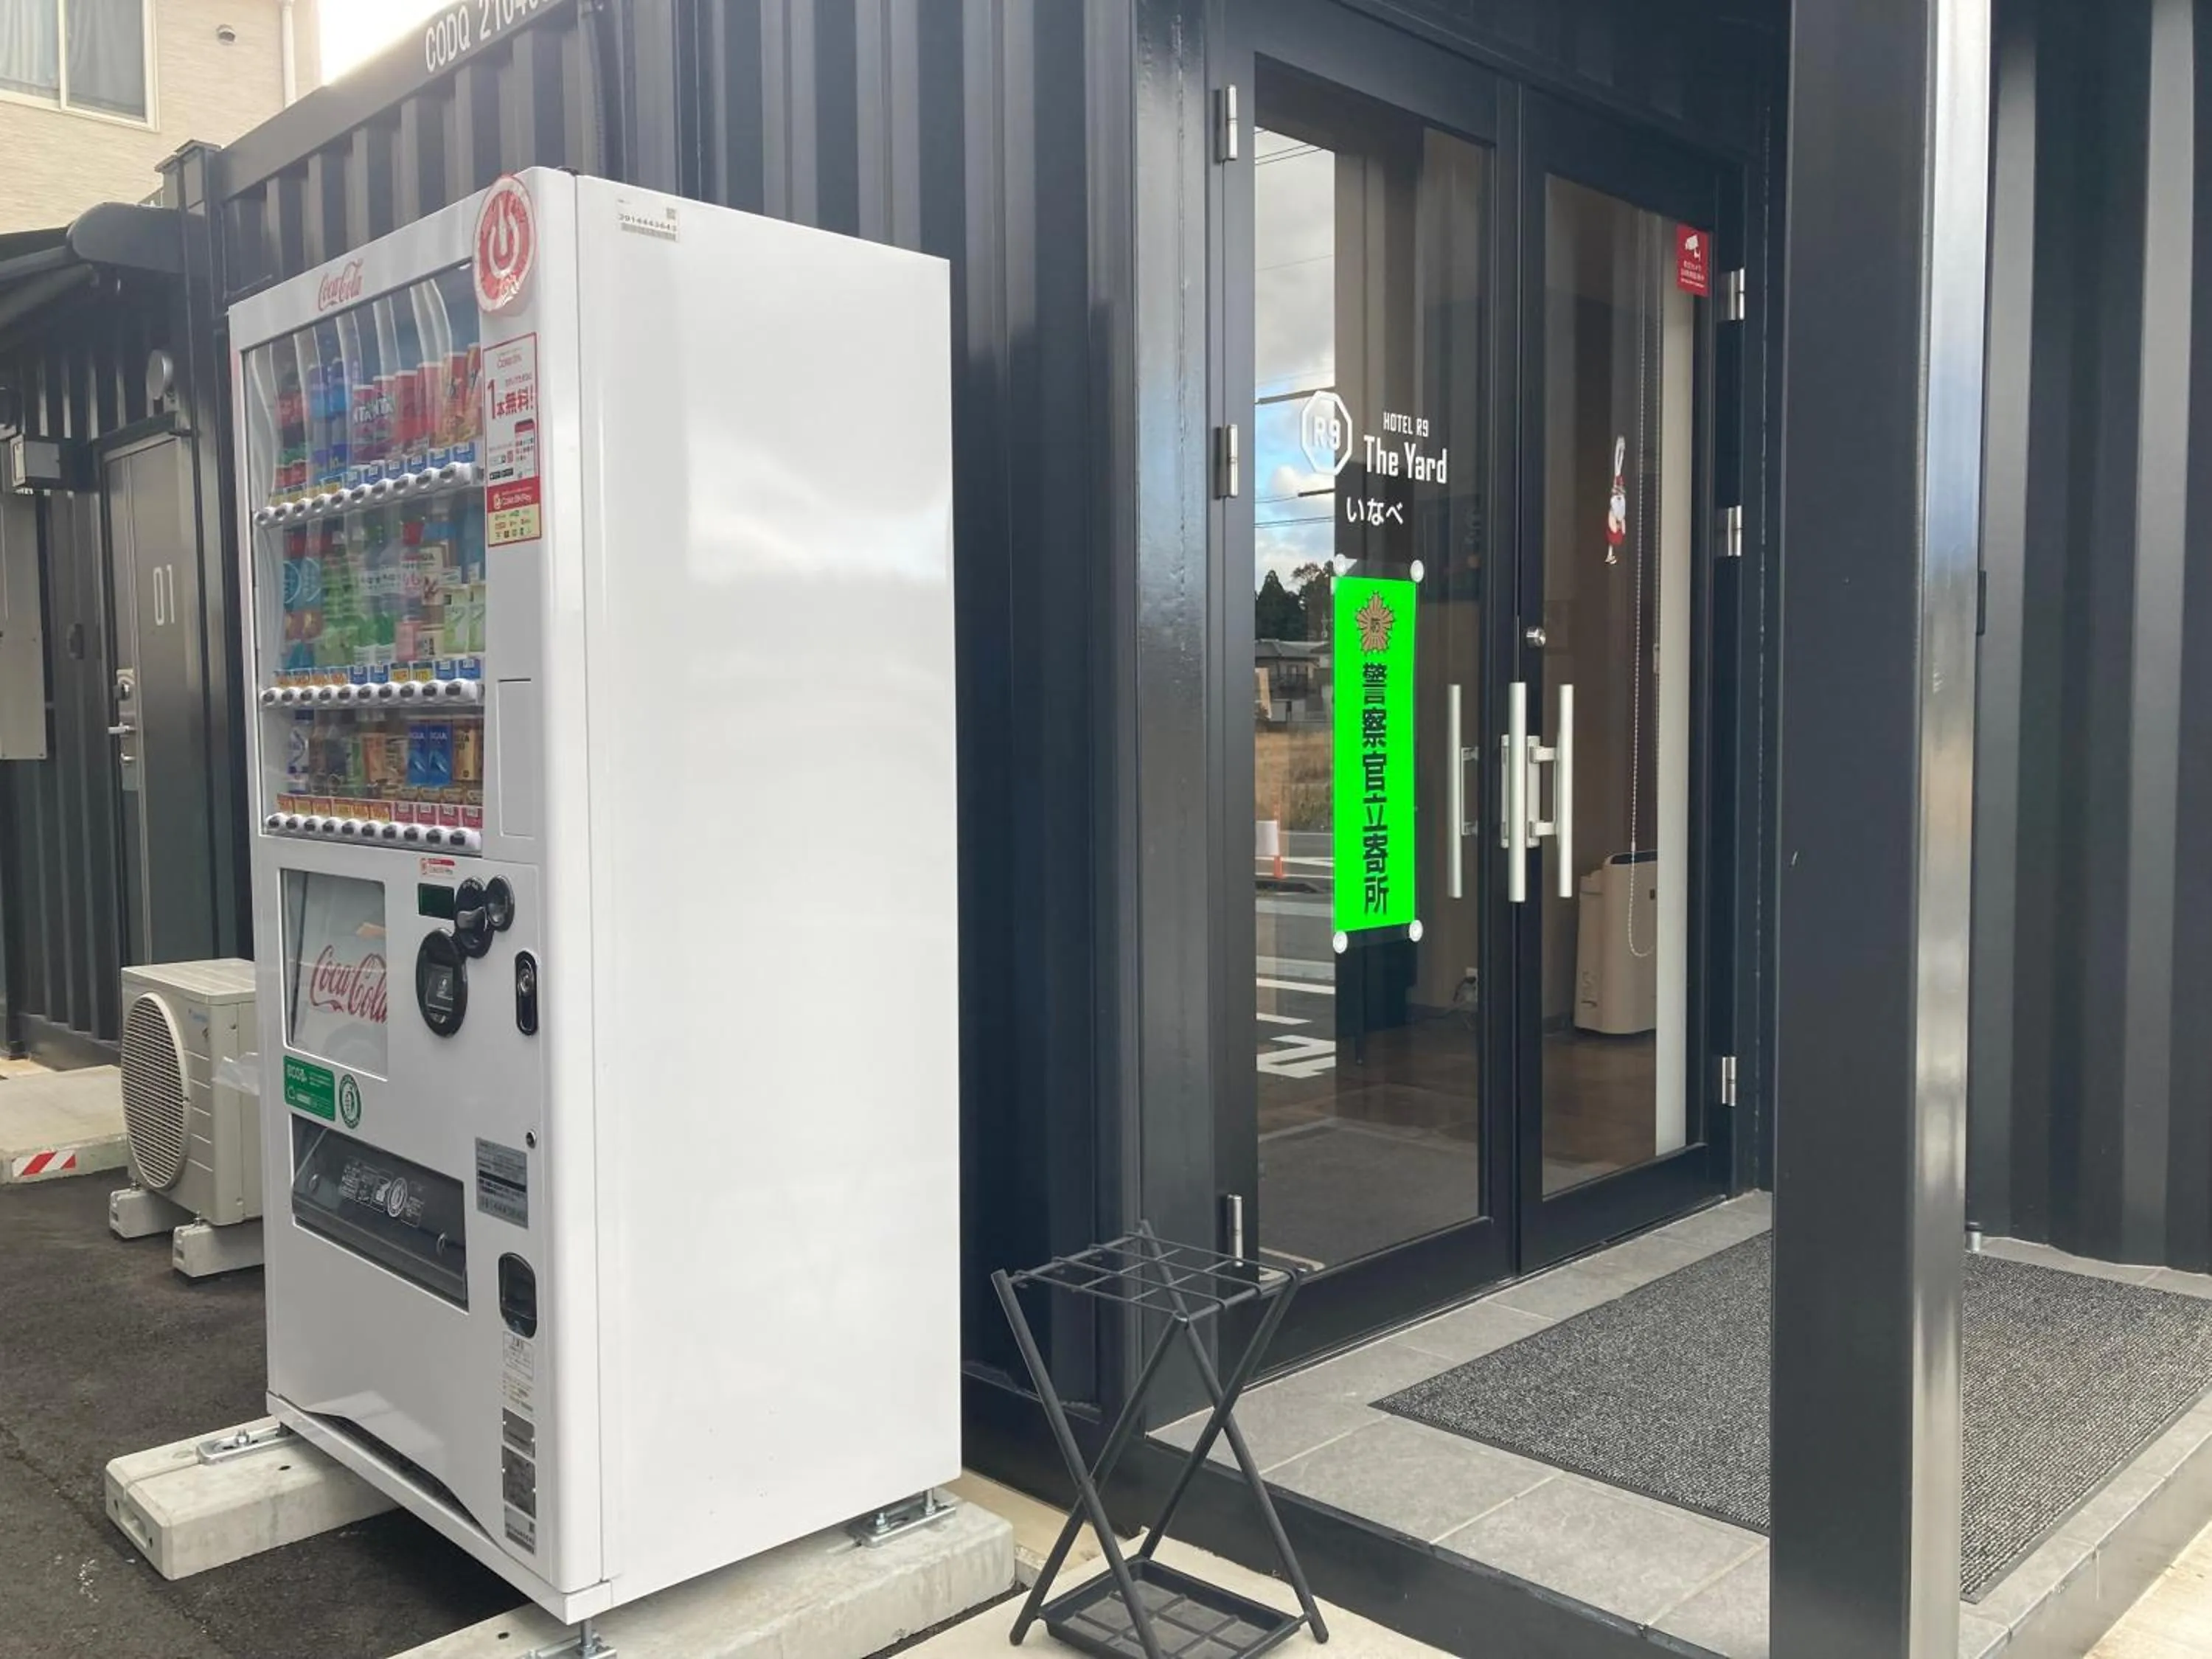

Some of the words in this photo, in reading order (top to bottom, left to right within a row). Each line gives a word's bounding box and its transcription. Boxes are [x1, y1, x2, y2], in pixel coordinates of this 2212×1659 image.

[425, 6, 470, 72] CODQ
[1312, 415, 1341, 451] R9
[1382, 411, 1413, 435] HOTEL
[1415, 417, 1429, 437] R9
[1363, 434, 1399, 476] The
[1404, 442, 1447, 484] Yard
[1346, 496, 1404, 526] いなべ
[153, 564, 175, 626] 01
[1362, 661, 1389, 916] 警察官立寄所
